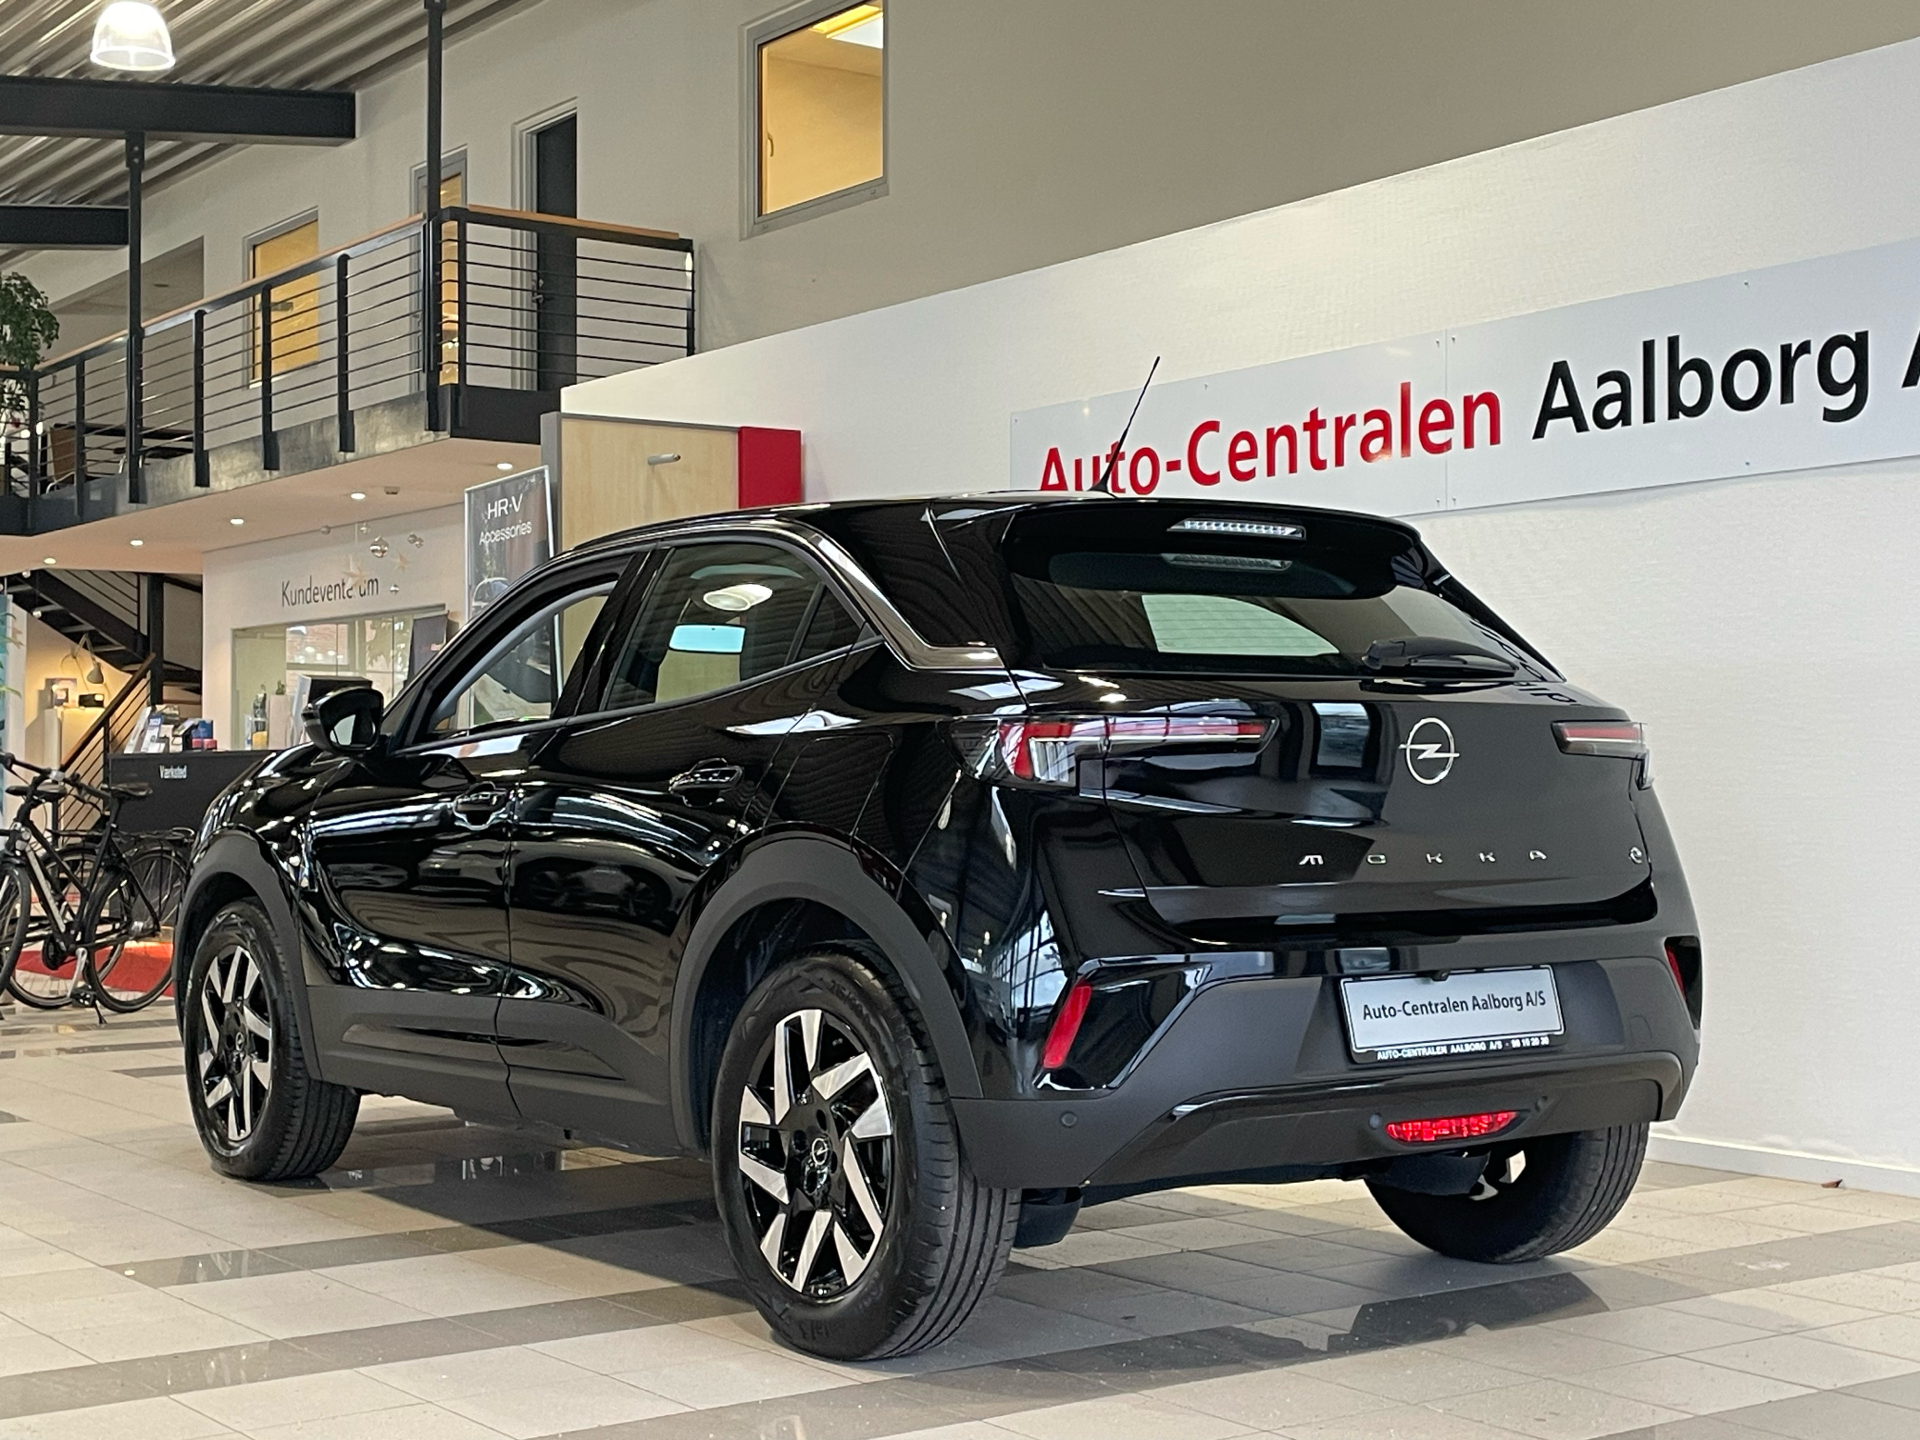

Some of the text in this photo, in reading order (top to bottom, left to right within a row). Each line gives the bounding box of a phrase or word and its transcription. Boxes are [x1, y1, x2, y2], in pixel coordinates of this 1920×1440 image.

[1039, 381, 1501, 496] Auto-Centralen
[1532, 329, 1869, 440] Aalborg
[487, 493, 523, 520] HR-V
[479, 519, 532, 546] Accessories
[281, 575, 379, 608] Kundeventeum
[1299, 849, 1548, 866] MOKKA
[1363, 990, 1547, 1020] Auto-Centralen Aalborg A/S
[1377, 1047, 1448, 1061] AUTO-CENTRALEN
[1450, 1041, 1487, 1054] AALBORG
[1489, 1039, 1503, 1050] A/S
